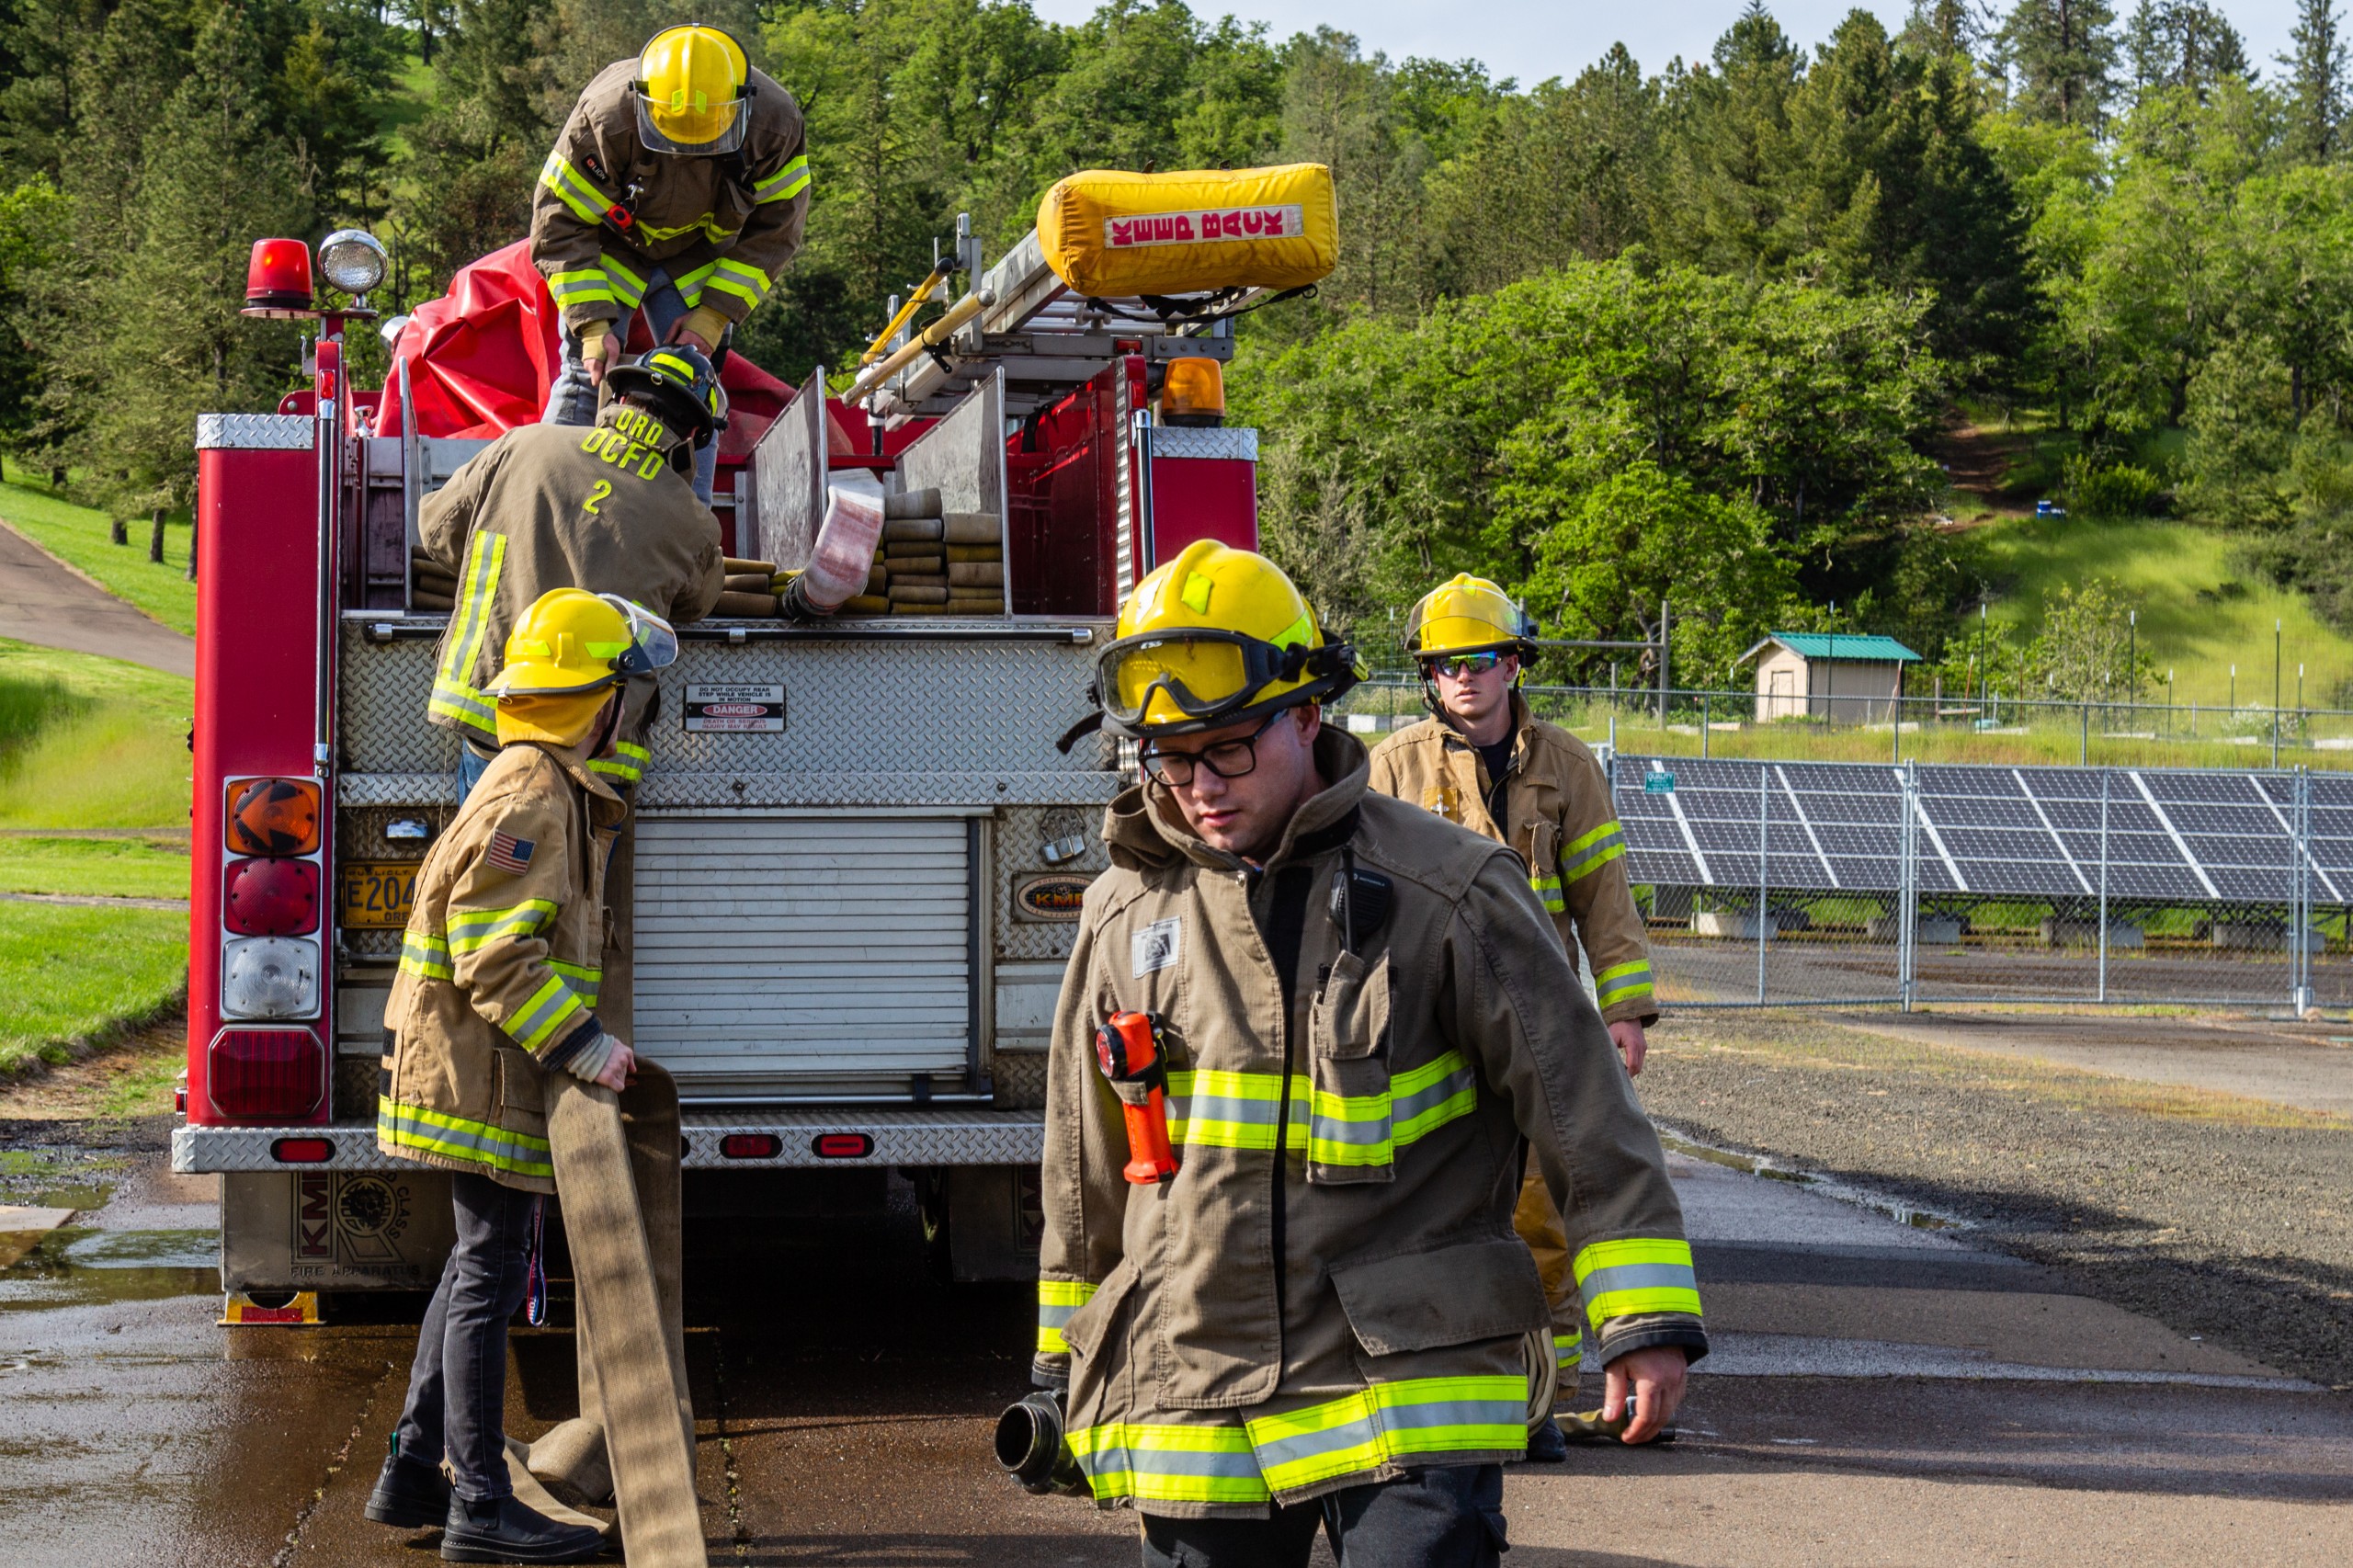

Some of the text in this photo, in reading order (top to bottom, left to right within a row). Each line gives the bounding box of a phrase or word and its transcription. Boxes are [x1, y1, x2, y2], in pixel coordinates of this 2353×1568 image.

[1112, 216, 1195, 246] KEEP
[1201, 210, 1283, 239] BACK
[615, 408, 664, 446] ORD
[579, 427, 665, 481] OCFD
[582, 479, 612, 516] 2
[713, 706, 758, 714] DANGER
[1647, 773, 1673, 781] QUALITY
[347, 877, 415, 911] E204
[384, 912, 410, 922] ORE
[389, 1186, 412, 1240] CLASS
[290, 1264, 421, 1278] FIRE APPARATUS
